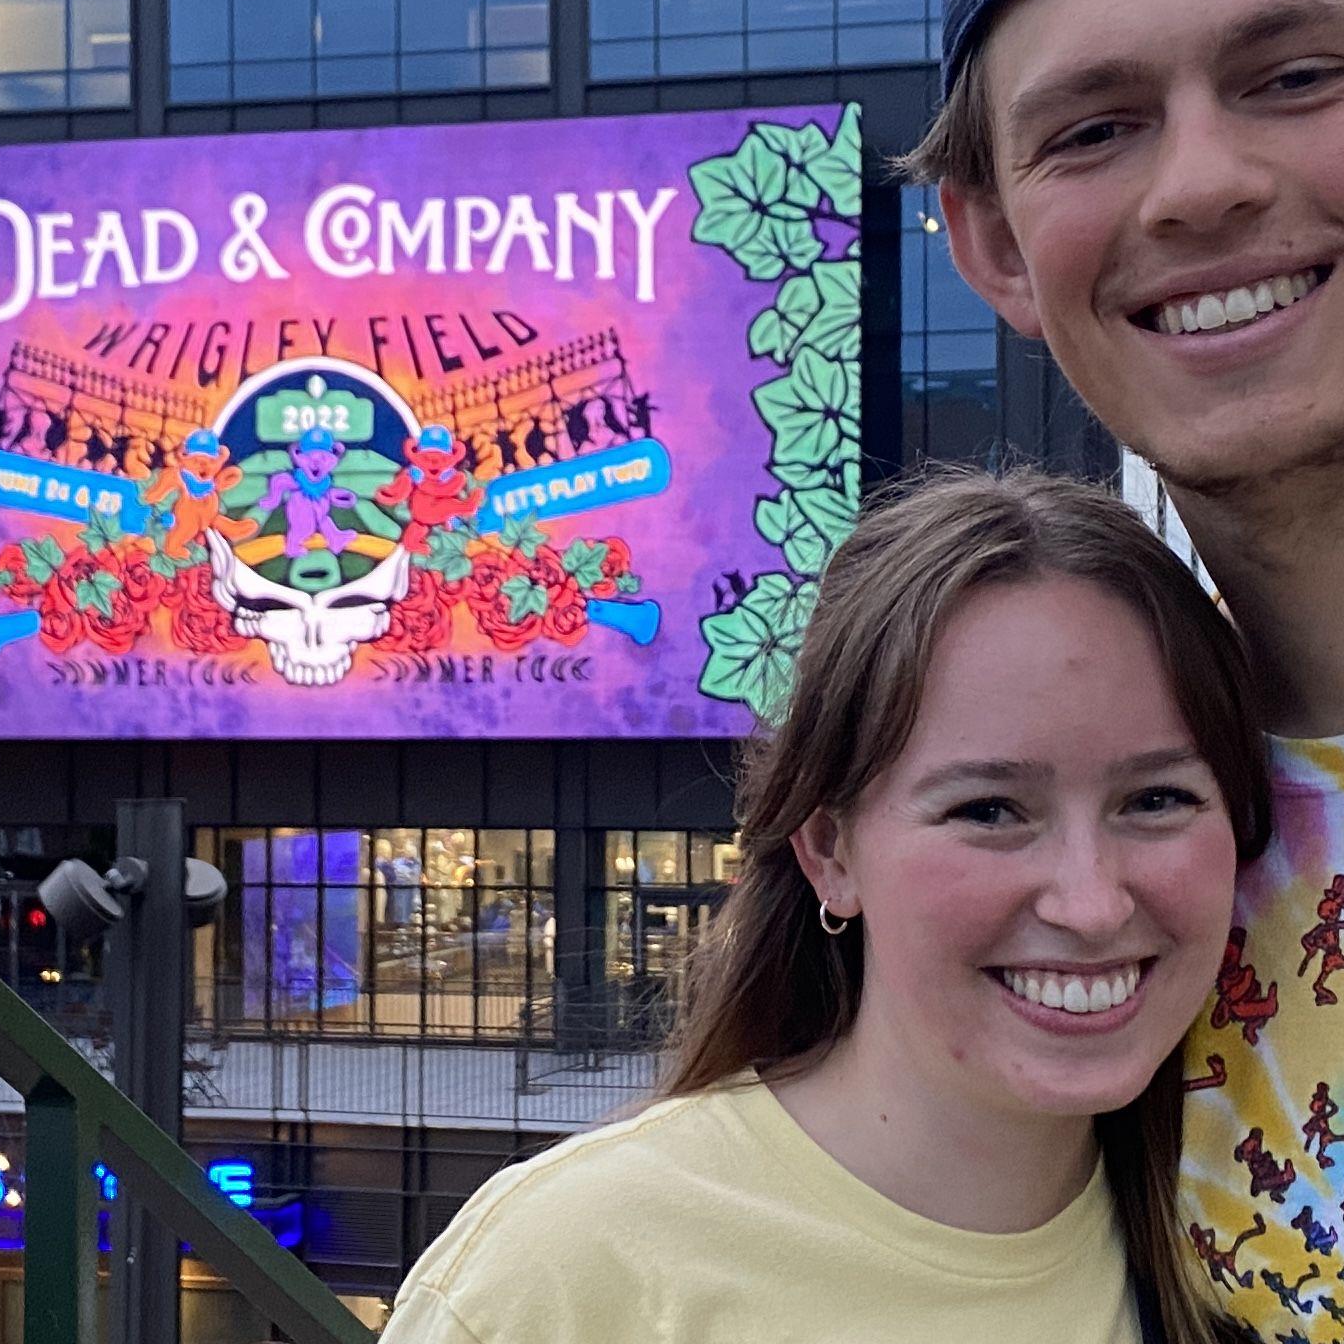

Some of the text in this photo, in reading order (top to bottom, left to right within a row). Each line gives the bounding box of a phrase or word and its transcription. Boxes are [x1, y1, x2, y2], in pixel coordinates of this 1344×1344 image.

[220, 191, 291, 283] &
[304, 183, 679, 303] COMPANY
[84, 311, 539, 389] WRIGLEY FIELD
[282, 404, 351, 433] 2022
